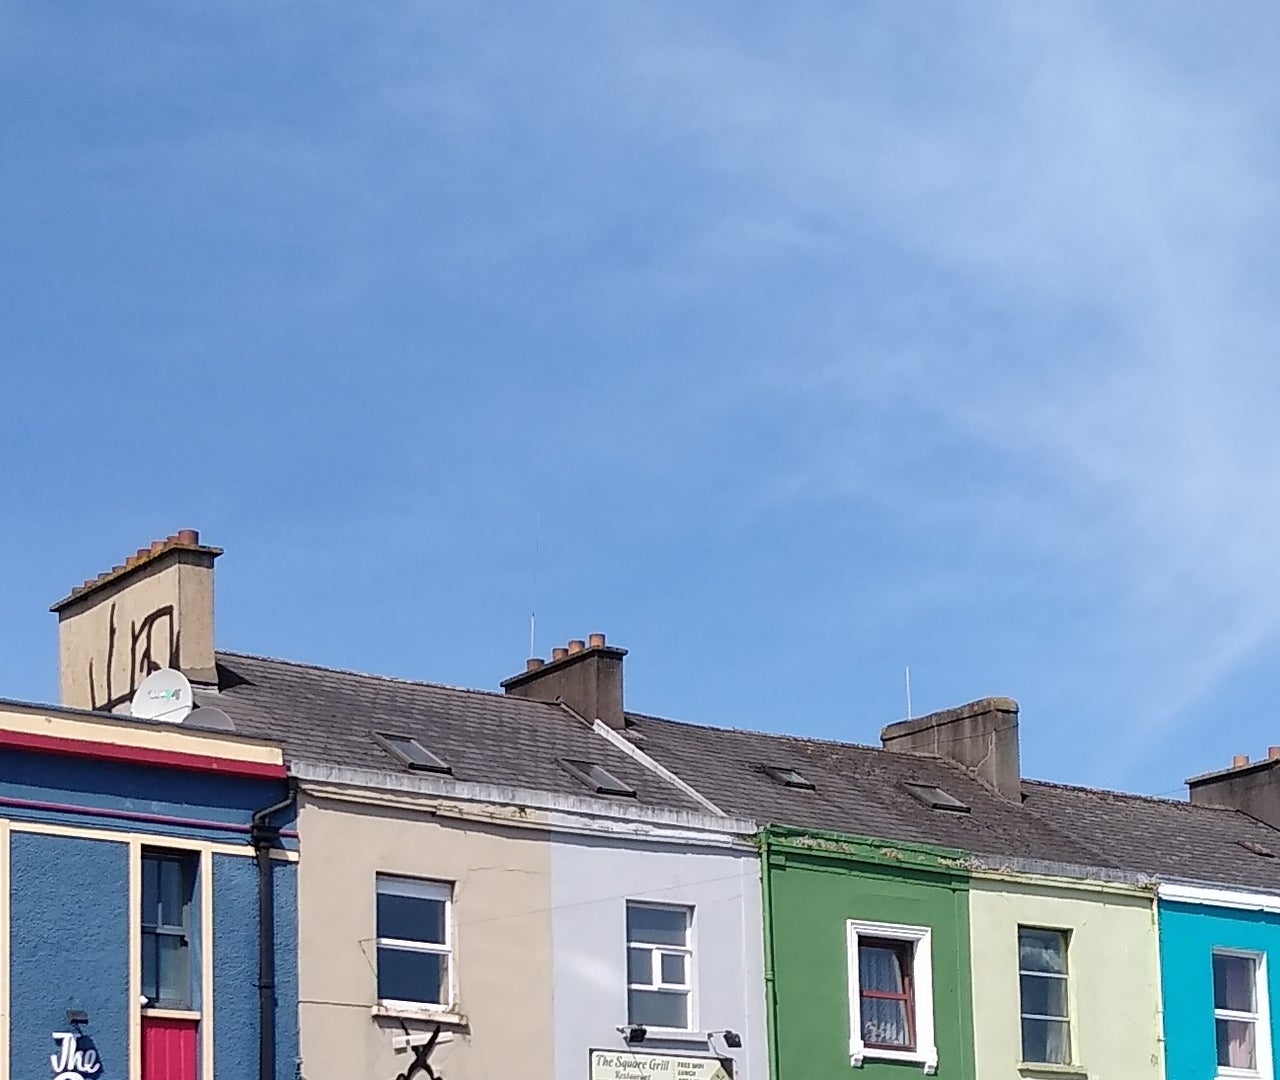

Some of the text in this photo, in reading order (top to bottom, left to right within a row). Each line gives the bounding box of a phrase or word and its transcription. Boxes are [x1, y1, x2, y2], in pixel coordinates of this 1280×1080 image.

[51, 1032, 100, 1073] The
[596, 1054, 670, 1071] The Square Grill
